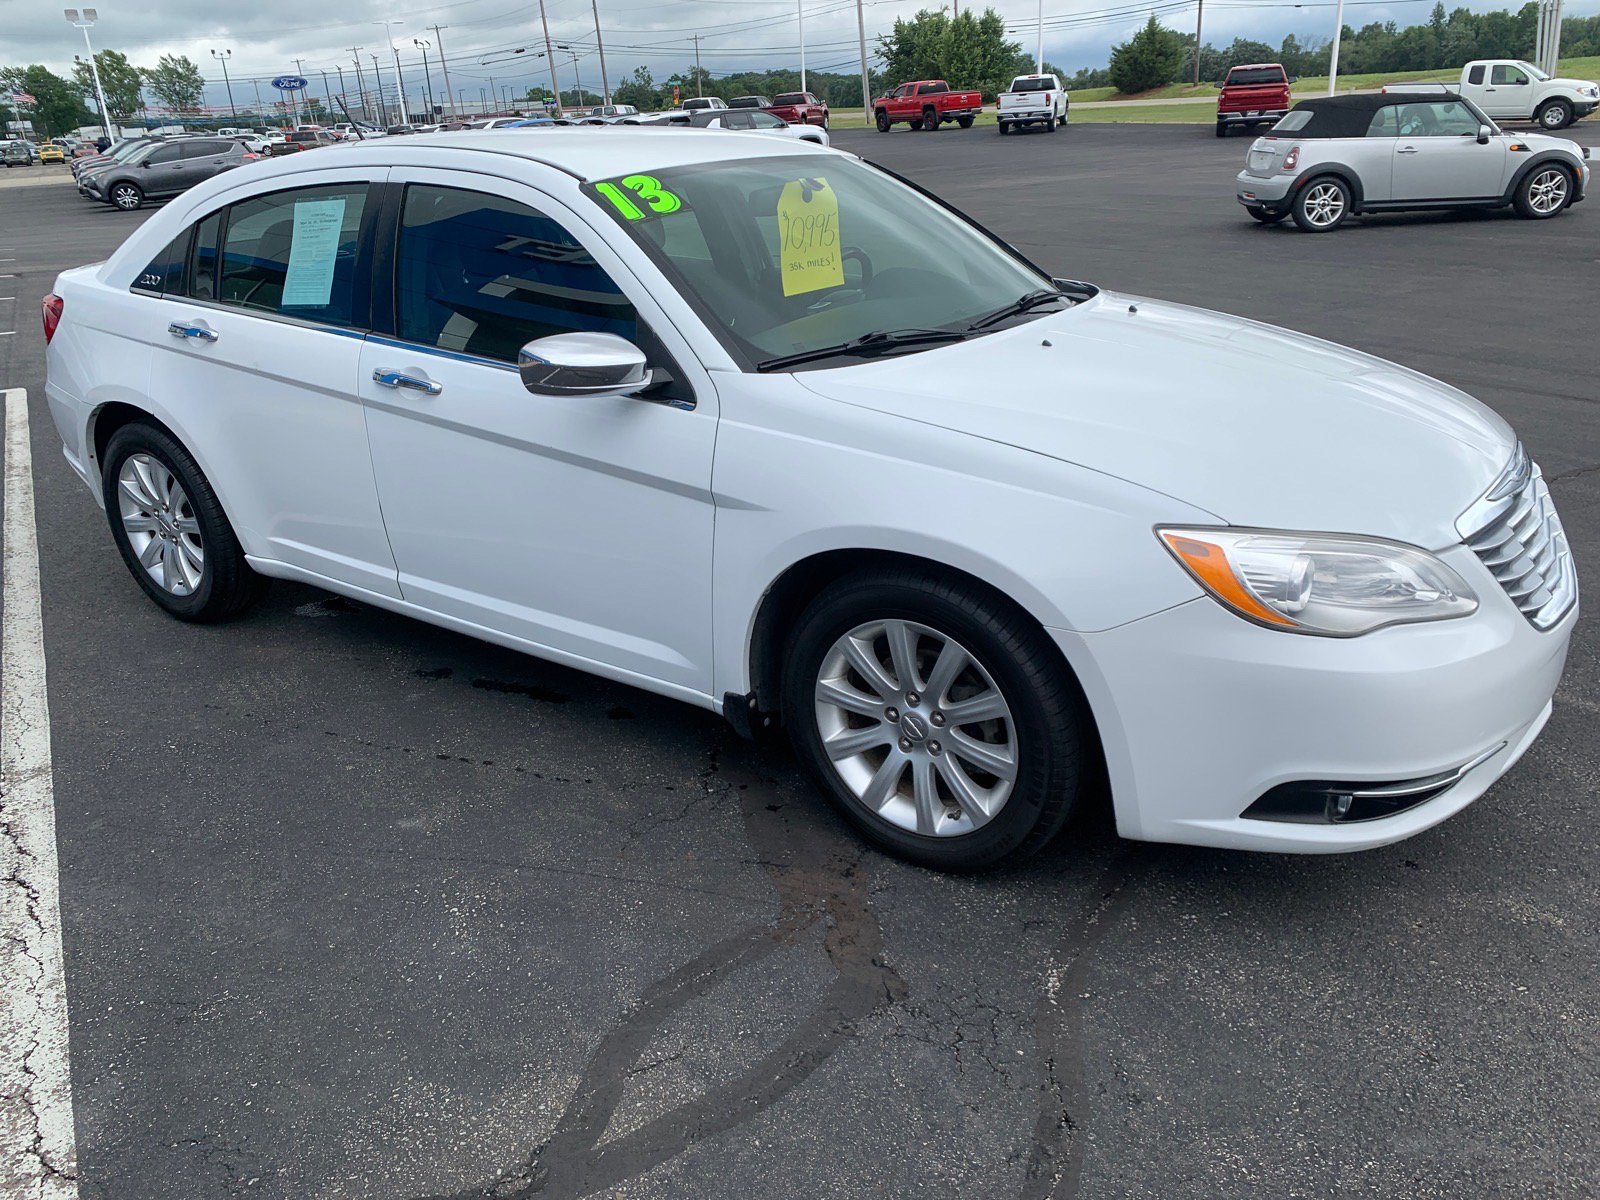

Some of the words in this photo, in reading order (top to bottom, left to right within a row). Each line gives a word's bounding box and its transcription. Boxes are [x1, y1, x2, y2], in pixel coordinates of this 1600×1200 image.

[280, 78, 300, 87] Ford
[595, 174, 682, 220] 13
[789, 262, 805, 272] 35K
[140, 273, 161, 286] 200
